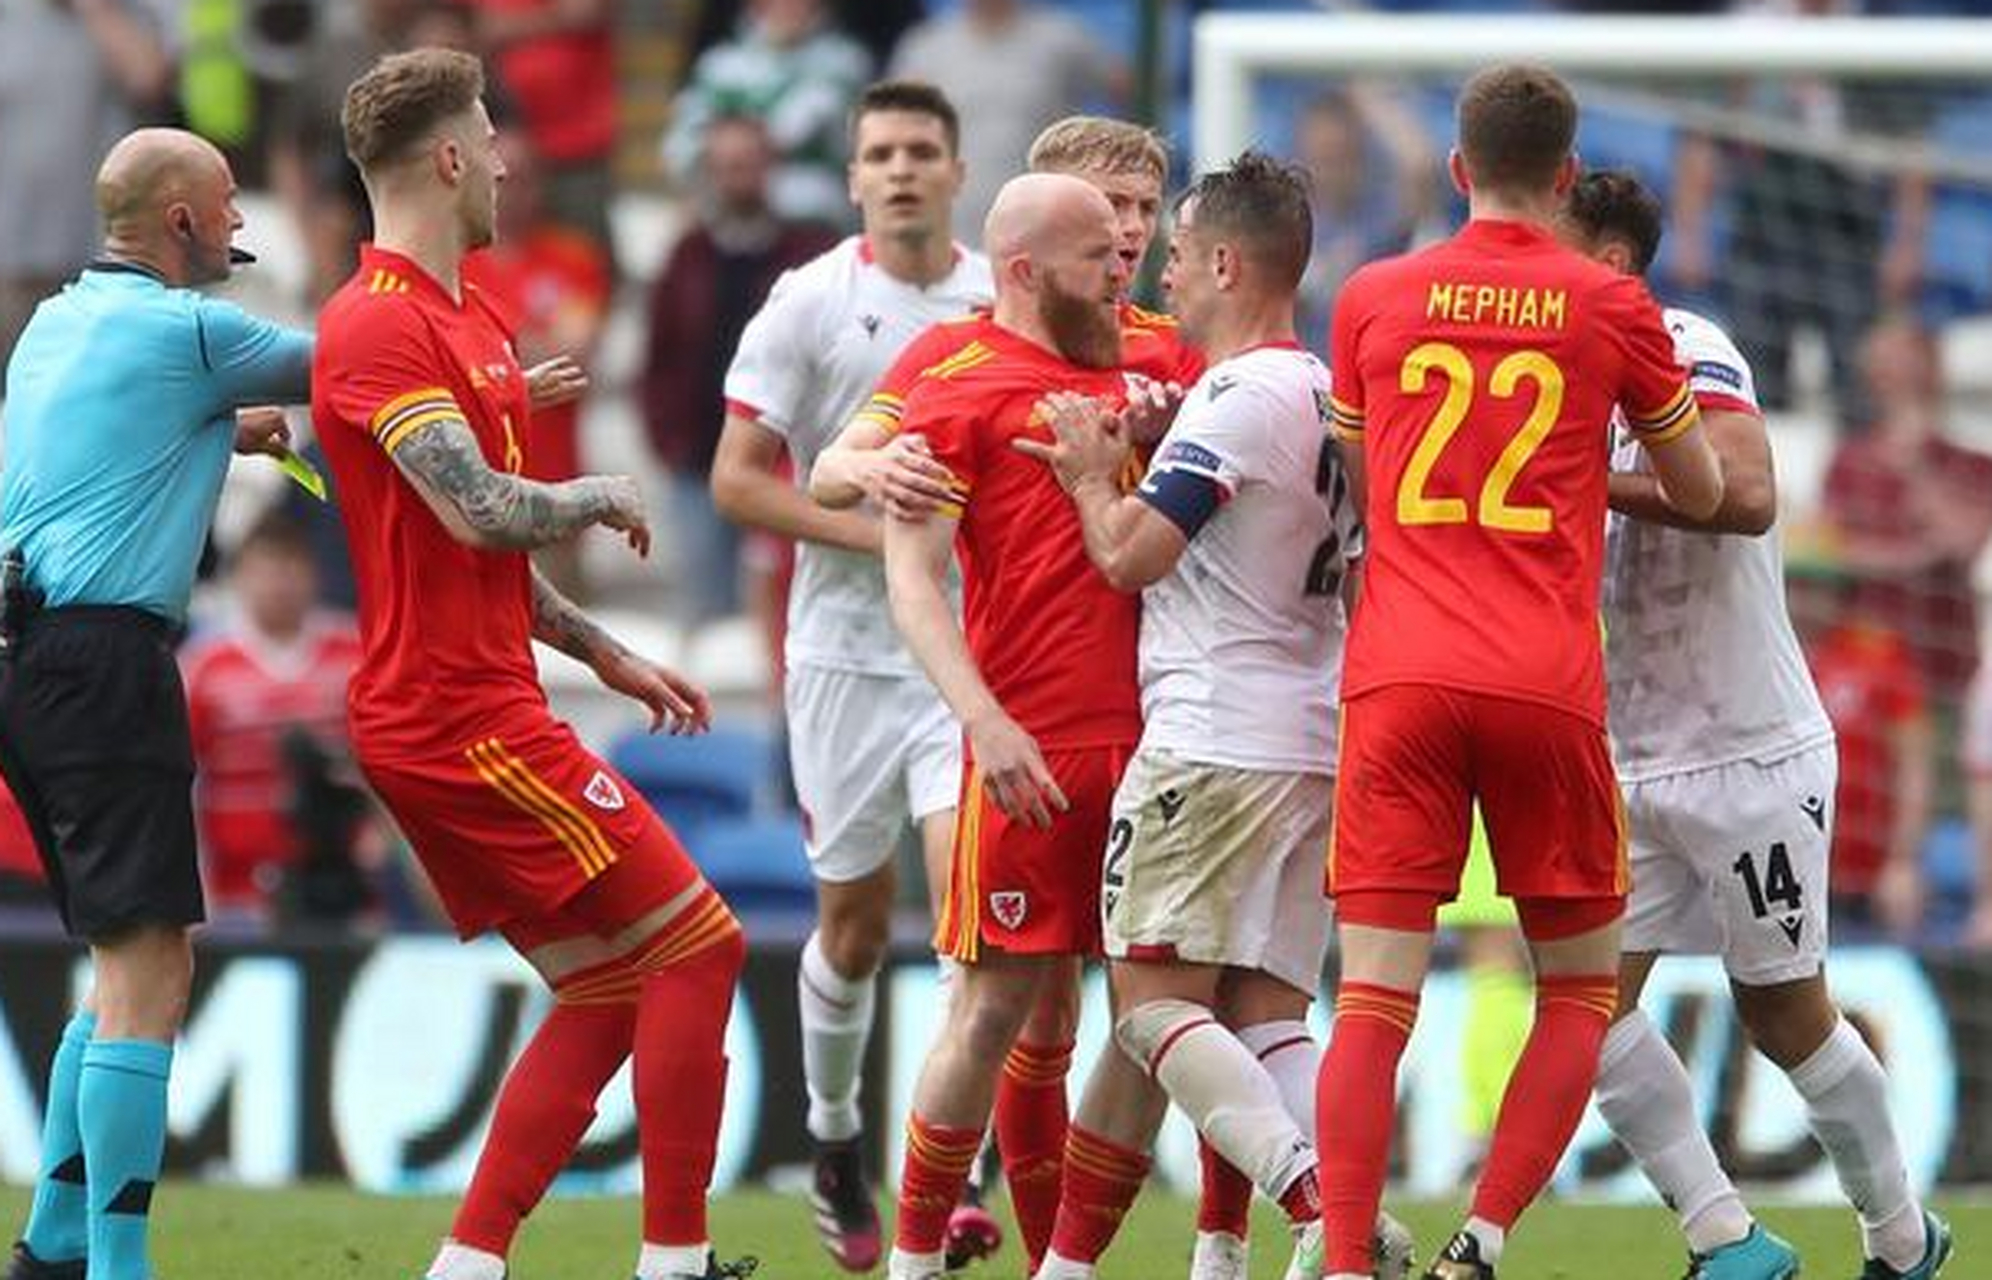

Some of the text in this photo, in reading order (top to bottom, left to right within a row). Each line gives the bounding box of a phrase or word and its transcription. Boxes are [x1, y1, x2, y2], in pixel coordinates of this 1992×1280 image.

[1426, 282, 1567, 331] MEPHAM
[1397, 341, 1565, 533] 22
[1732, 841, 1803, 919] 14
